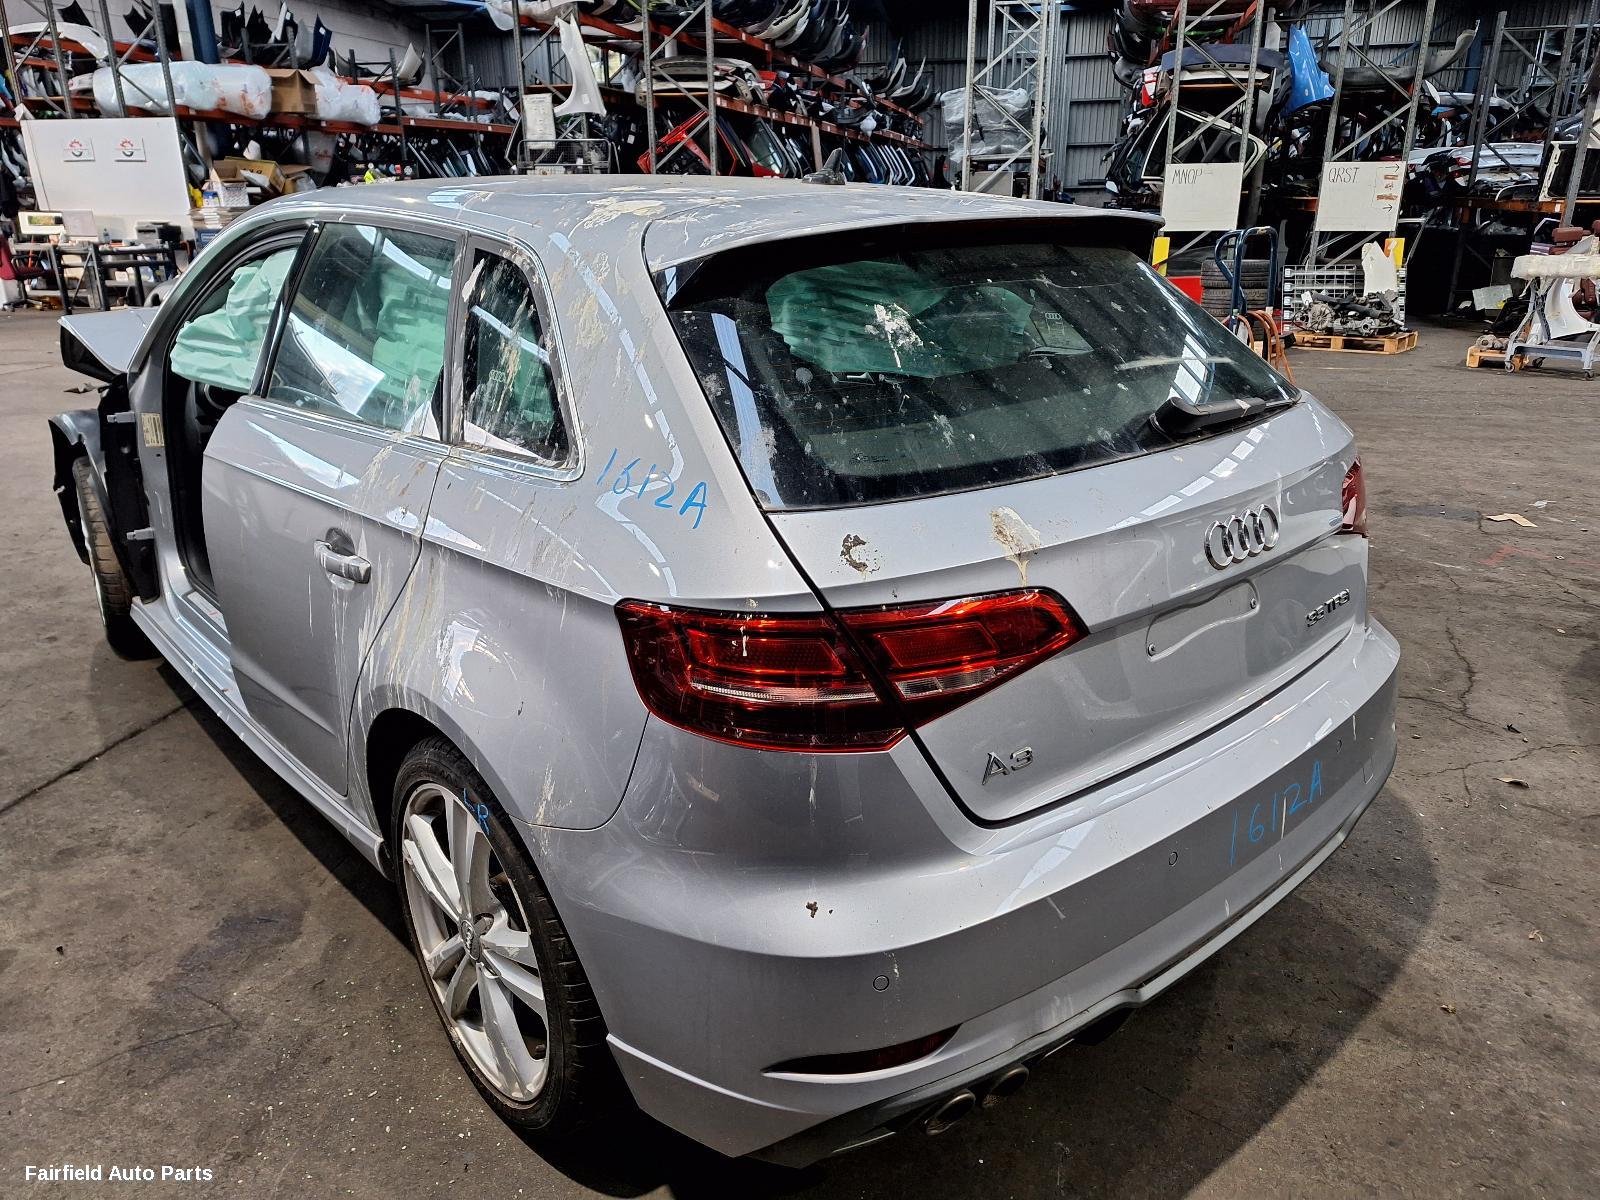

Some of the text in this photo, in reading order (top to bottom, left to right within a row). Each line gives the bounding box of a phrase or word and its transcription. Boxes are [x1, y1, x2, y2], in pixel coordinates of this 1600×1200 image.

[1171, 168, 1203, 185] MNOP
[1328, 166, 1360, 184] QRST
[596, 447, 708, 529] 1612A
[1305, 605, 1325, 628] 35
[981, 746, 1033, 786] A3
[463, 786, 490, 836] LR
[1229, 759, 1323, 867] 1612A
